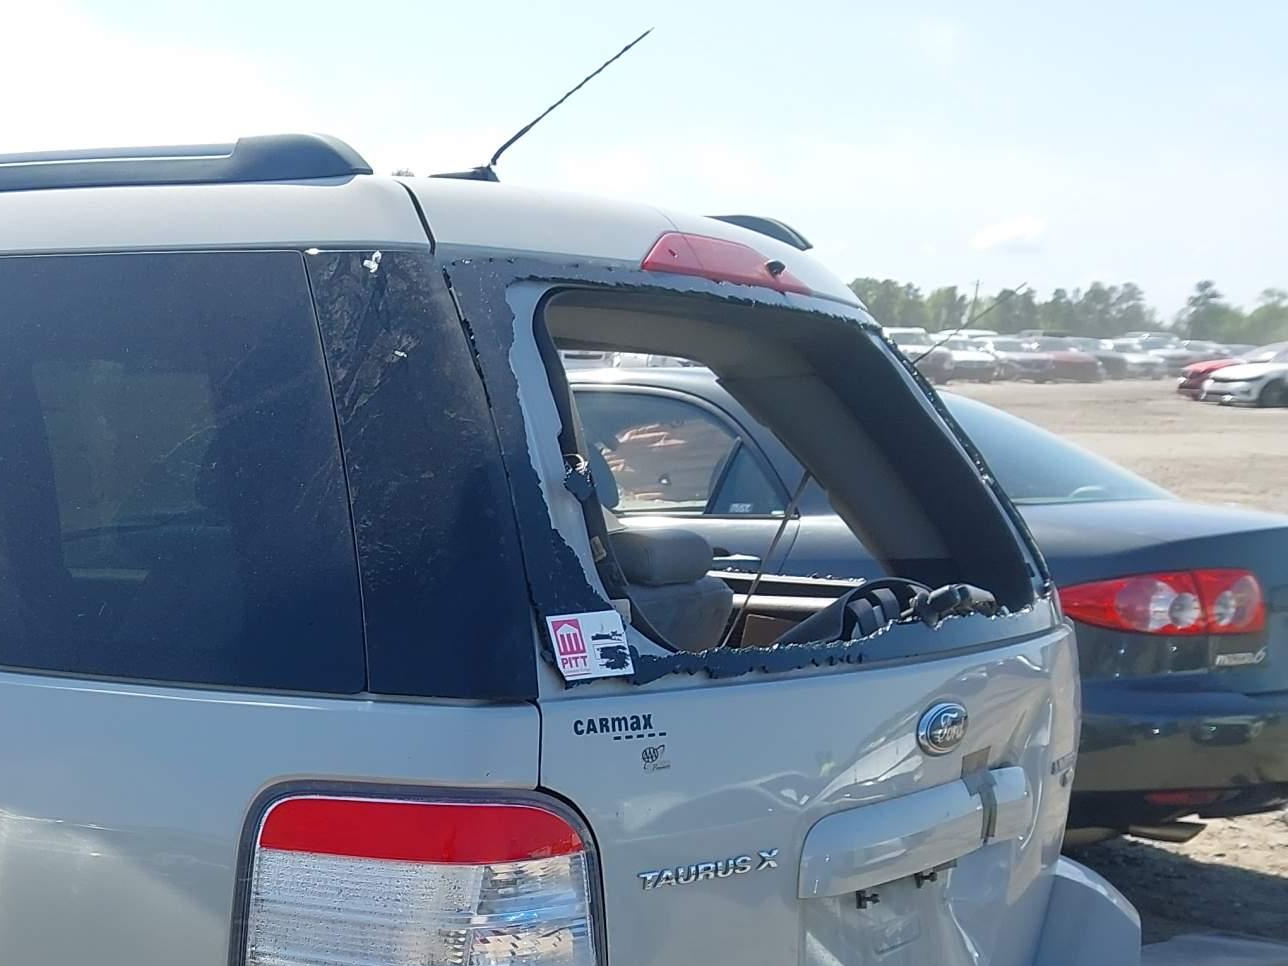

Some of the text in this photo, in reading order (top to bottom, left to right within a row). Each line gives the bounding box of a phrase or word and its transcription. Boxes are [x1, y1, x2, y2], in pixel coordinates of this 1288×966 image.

[560, 655, 588, 670] PITT
[931, 711, 963, 743] Ford
[638, 848, 780, 891] TAURUS X
